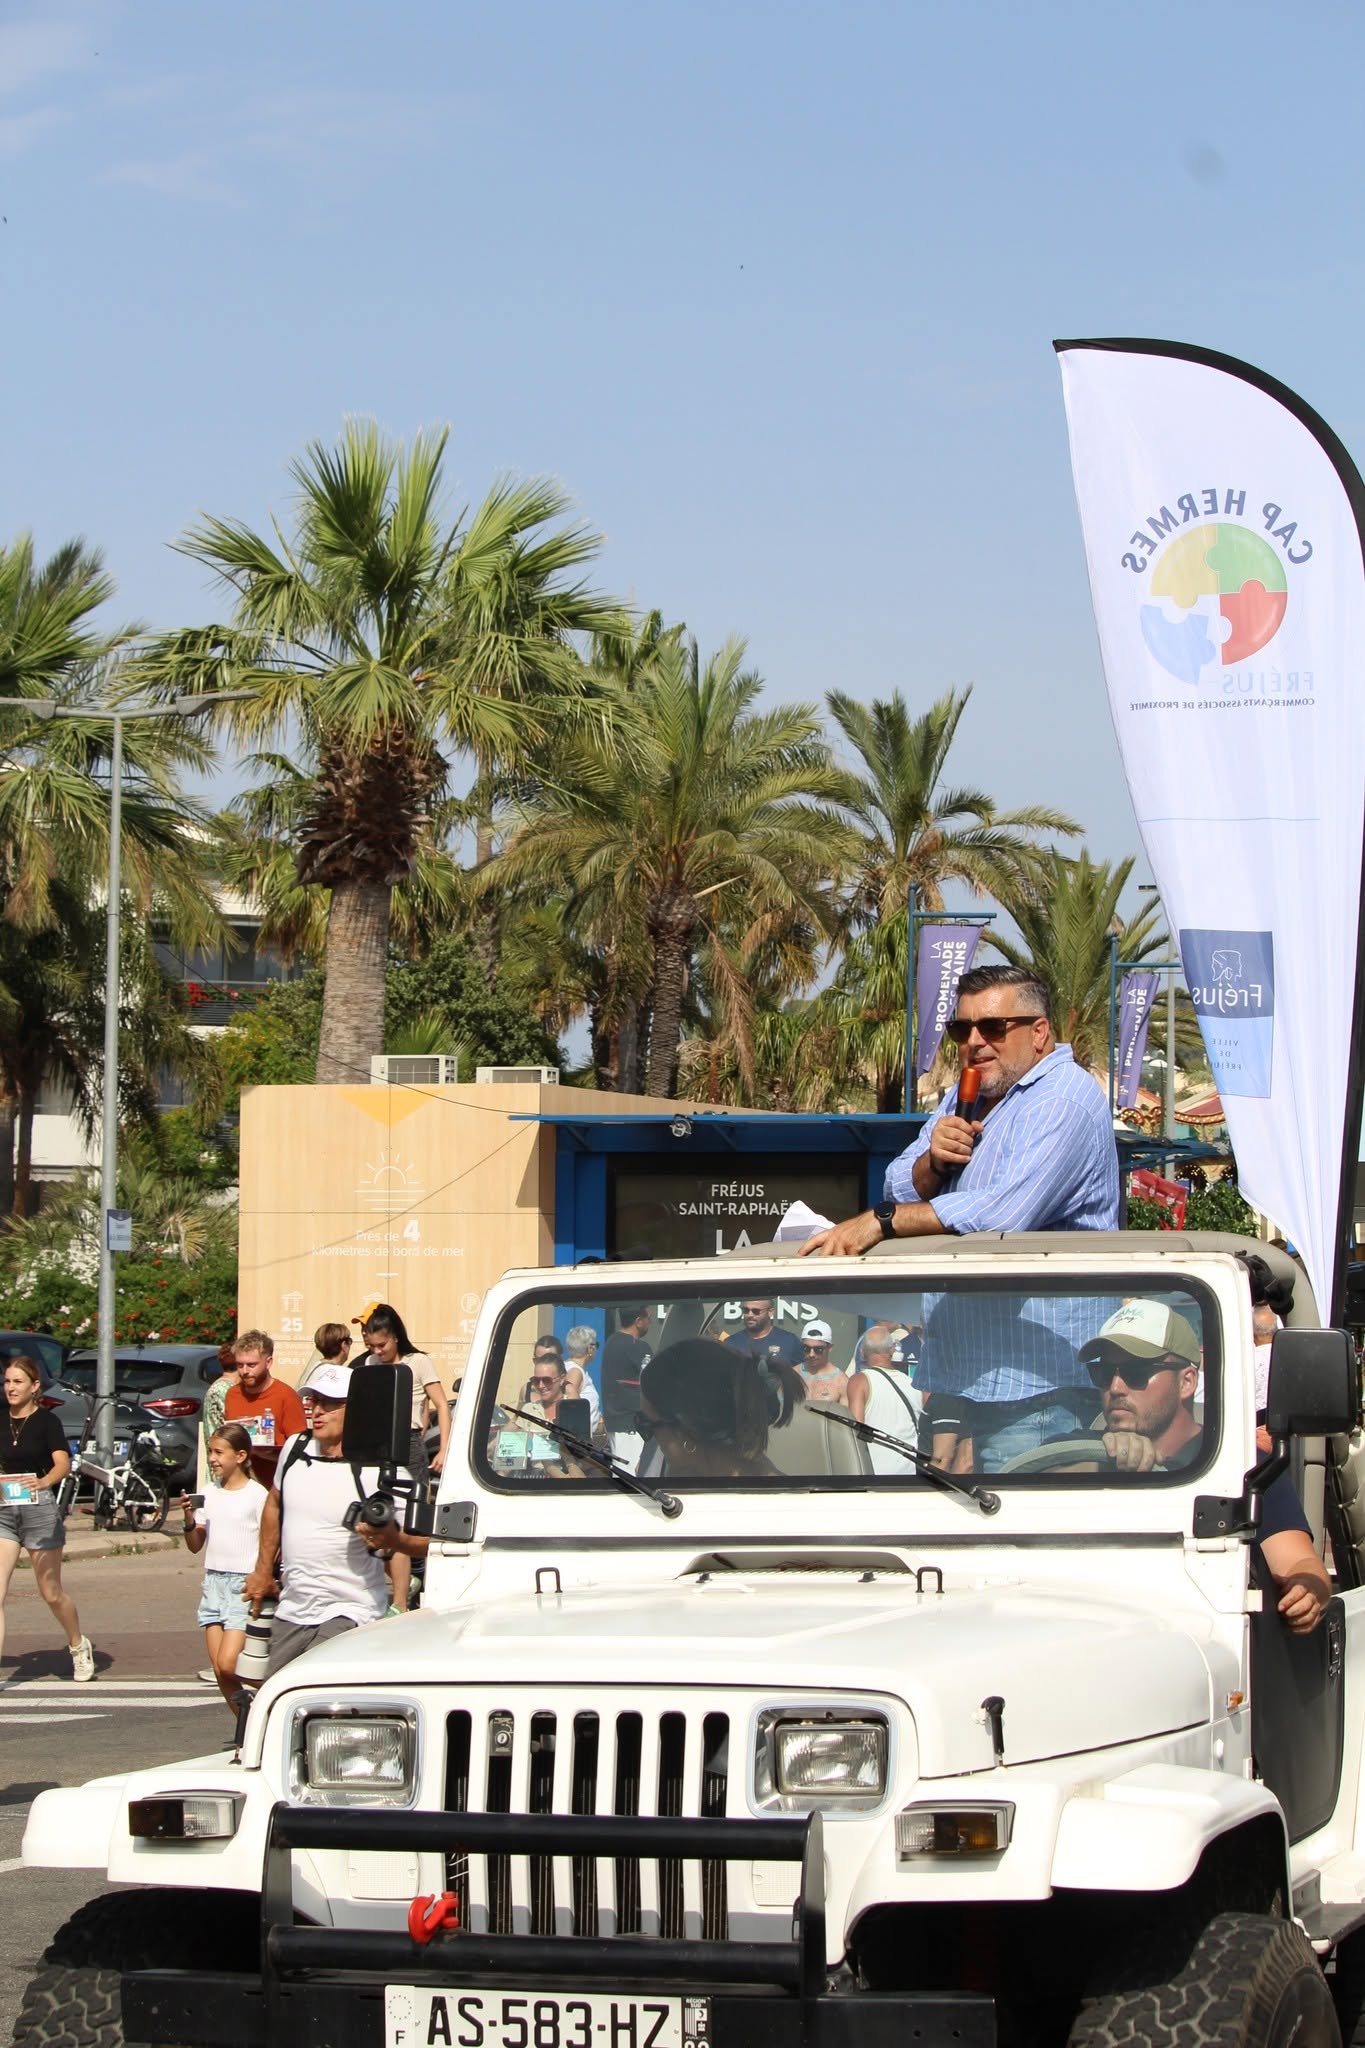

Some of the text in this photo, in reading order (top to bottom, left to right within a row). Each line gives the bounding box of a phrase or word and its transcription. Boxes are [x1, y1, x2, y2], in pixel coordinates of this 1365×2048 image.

[930, 941, 942, 958] LA
[935, 941, 954, 1031] PROMENADE
[1127, 988, 1137, 1004] LA
[711, 1181, 764, 1198] FRÉJUS
[678, 1199, 792, 1216] SAINT-RAPHAË
[356, 1219, 420, 1242] Près de 4
[715, 1229, 752, 1255] LA
[374, 1245, 389, 1257] de
[392, 1245, 420, 1257] bord
[423, 1245, 439, 1257] de
[441, 1247, 464, 1257] mer
[723, 1296, 819, 1320] BNS
[281, 1317, 303, 1332] 25
[427, 1995, 670, 2048] AS-583-HZ
[395, 2030, 405, 2045] F
